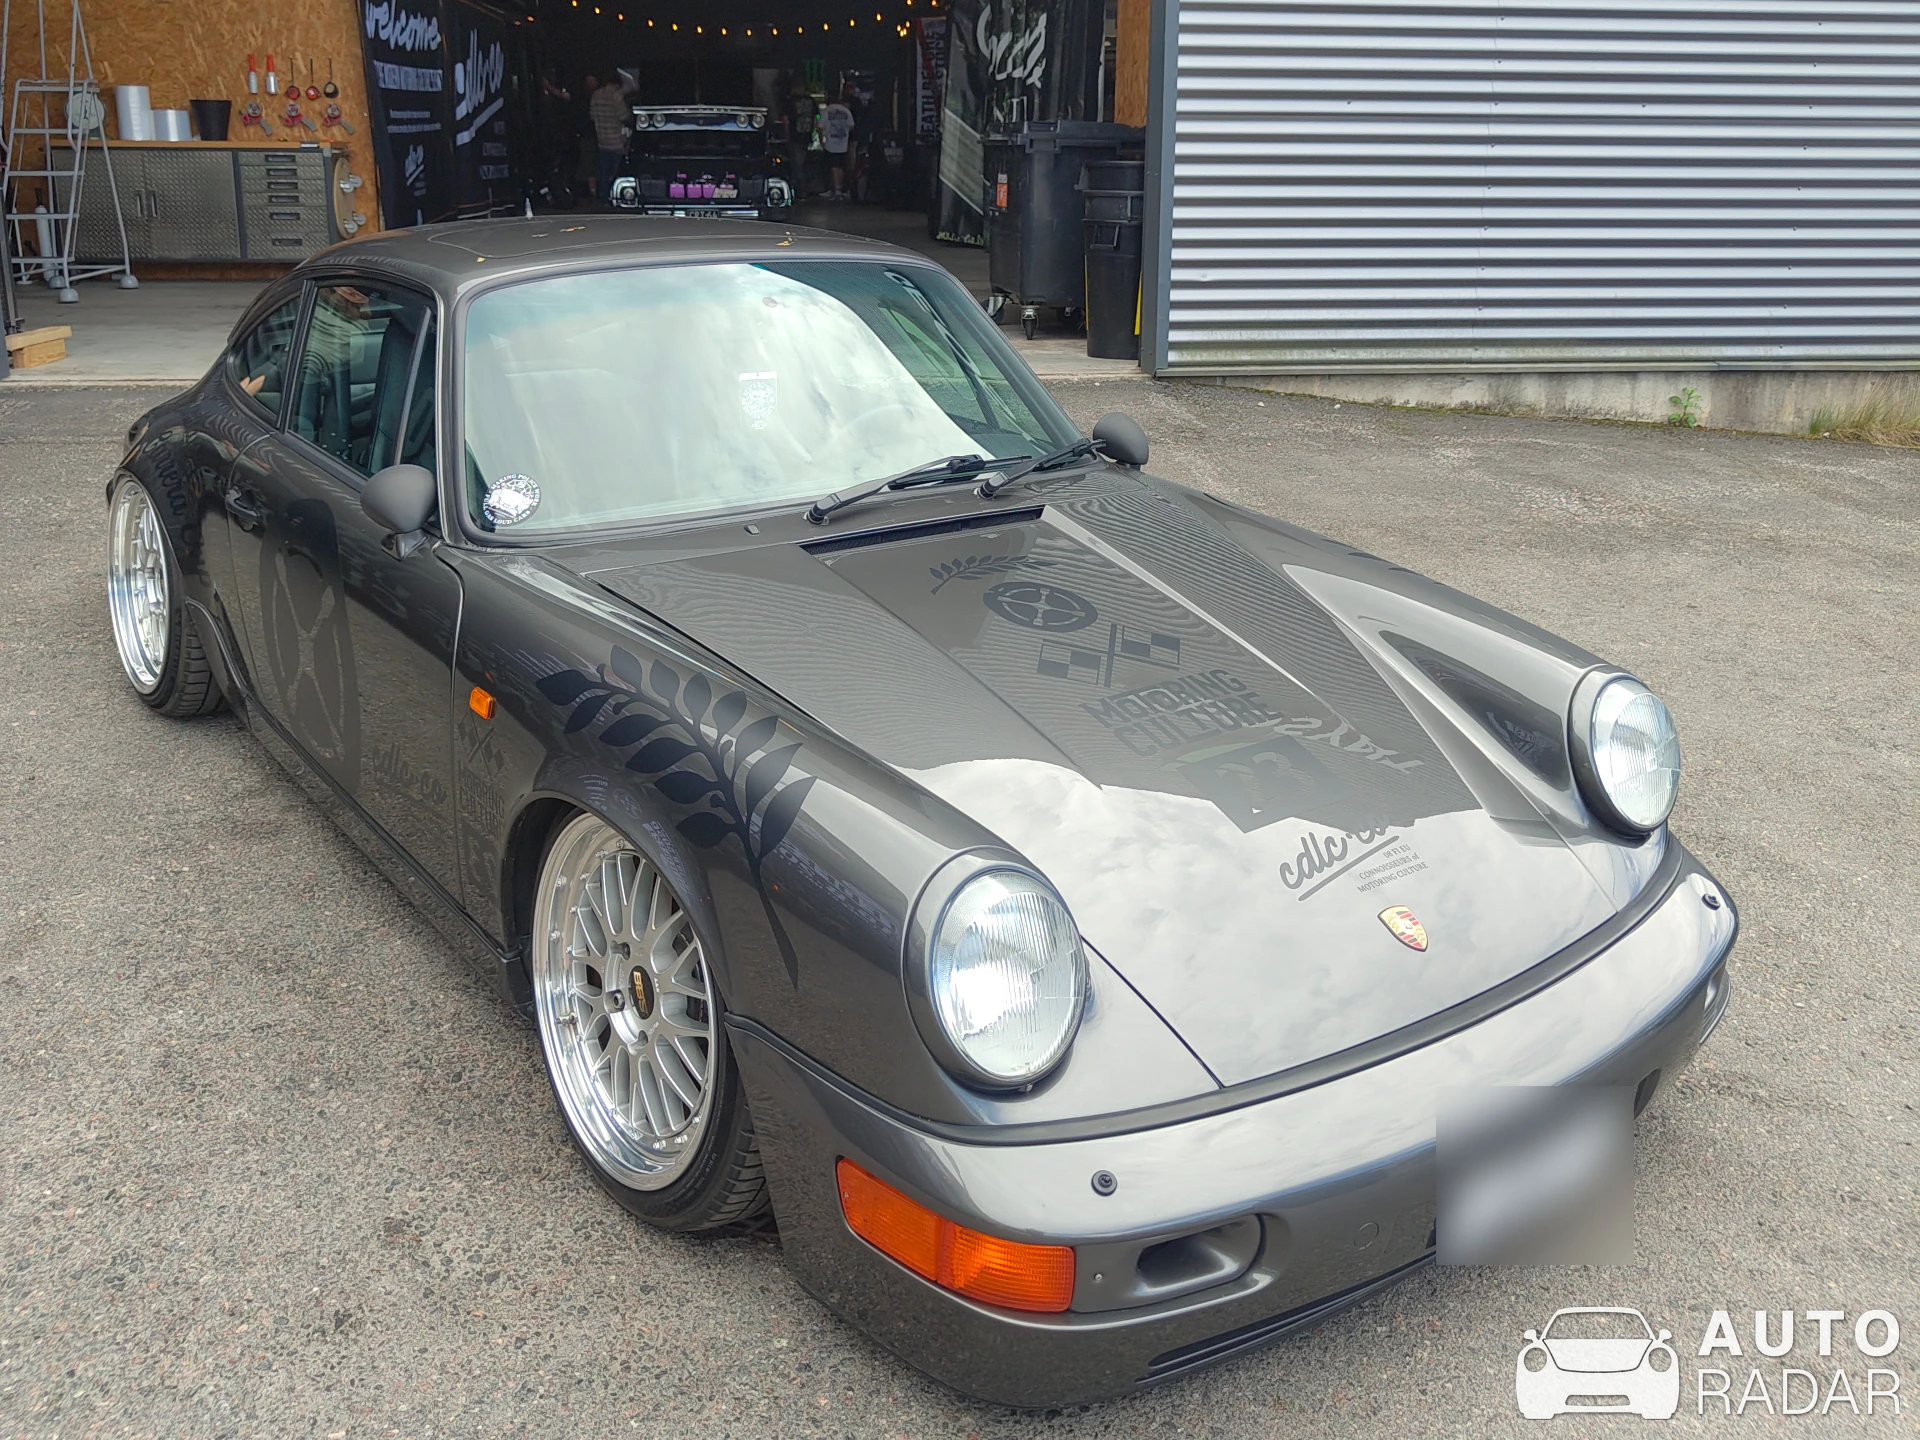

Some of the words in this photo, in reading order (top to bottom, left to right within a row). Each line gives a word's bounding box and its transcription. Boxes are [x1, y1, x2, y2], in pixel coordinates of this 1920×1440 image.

[365, 0, 442, 52] welcome
[1079, 668, 1248, 729] MOTORING
[1113, 691, 1283, 757] CULTURE
[1356, 873, 1398, 894] MOTORING
[1395, 861, 1429, 878] CULTURE
[1358, 855, 1413, 880] CONNOISSEURS
[632, 970, 650, 1016] BBS
